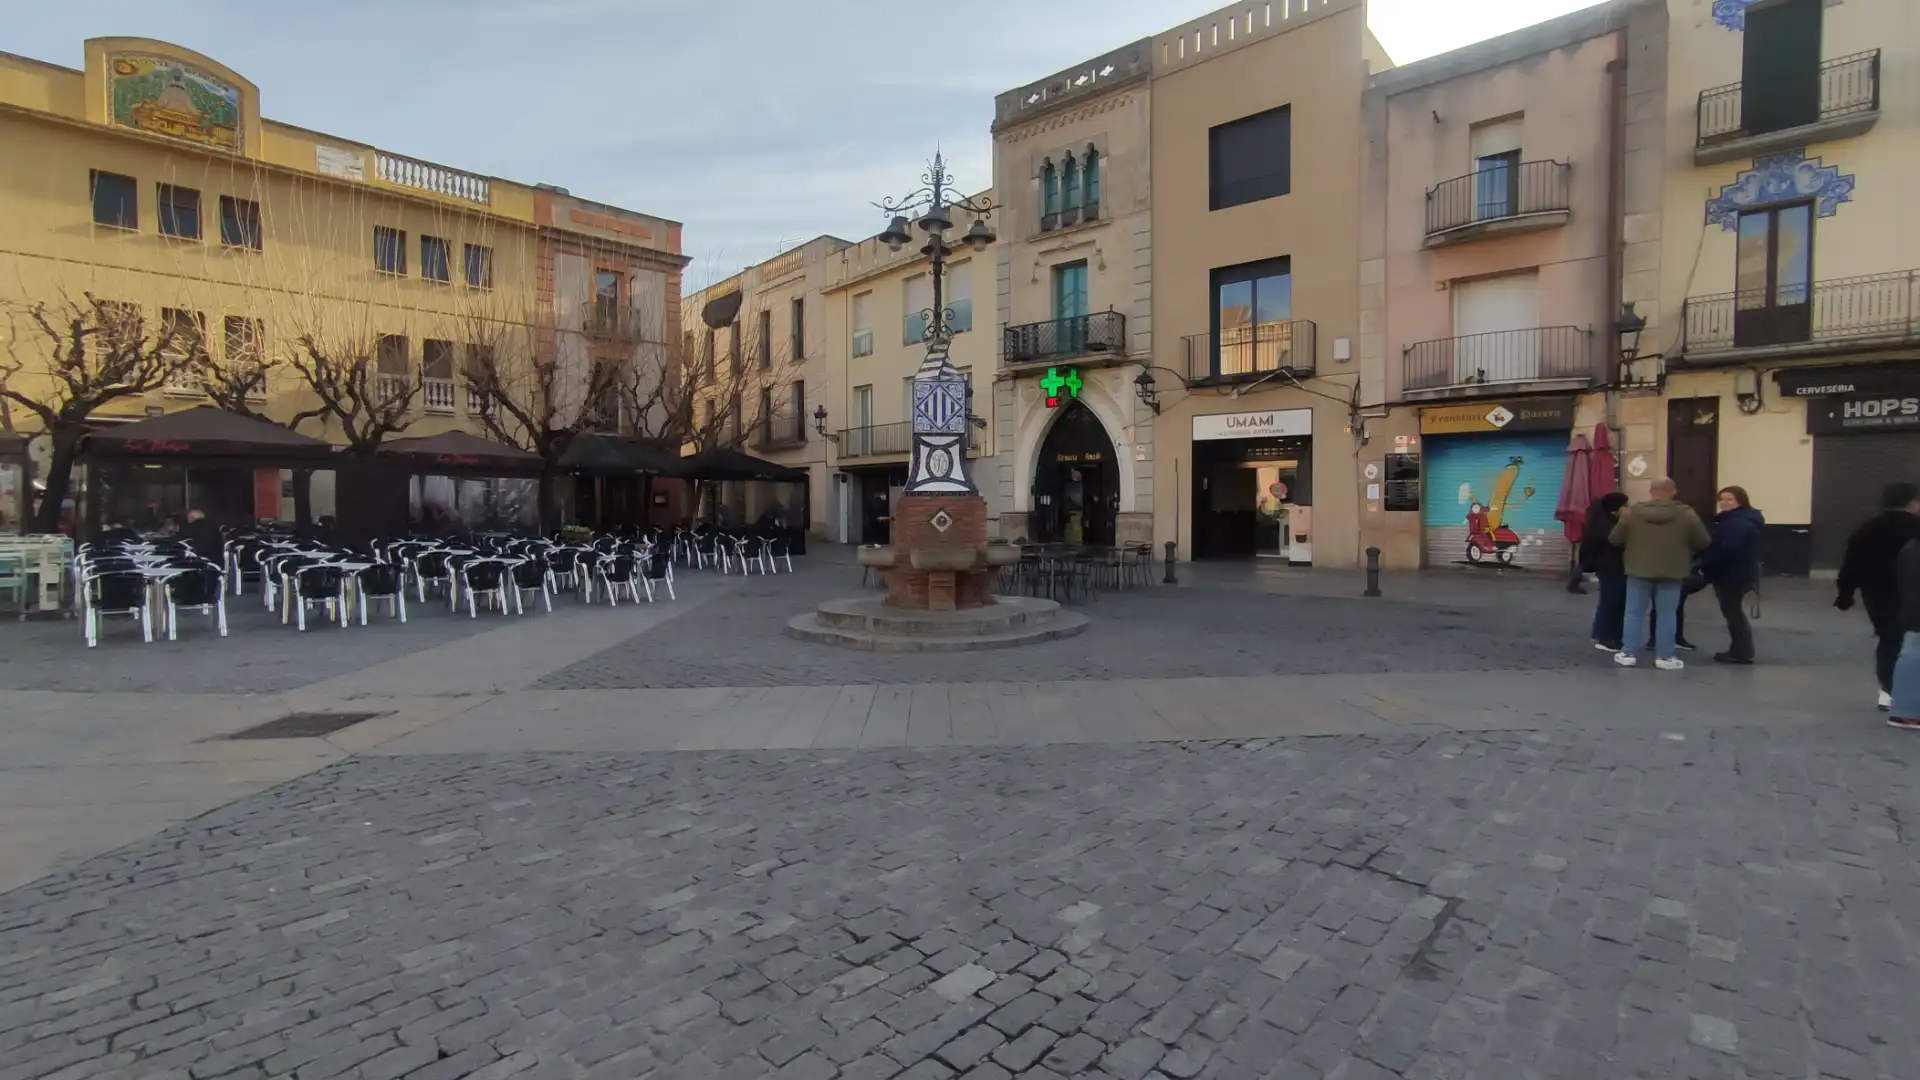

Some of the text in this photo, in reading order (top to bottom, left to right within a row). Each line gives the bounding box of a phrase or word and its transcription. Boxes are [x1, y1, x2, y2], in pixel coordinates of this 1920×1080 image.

[1796, 384, 1856, 395] CERVESERIA
[1843, 398, 1919, 418] HOPS
[1226, 413, 1274, 428] UMAMI
